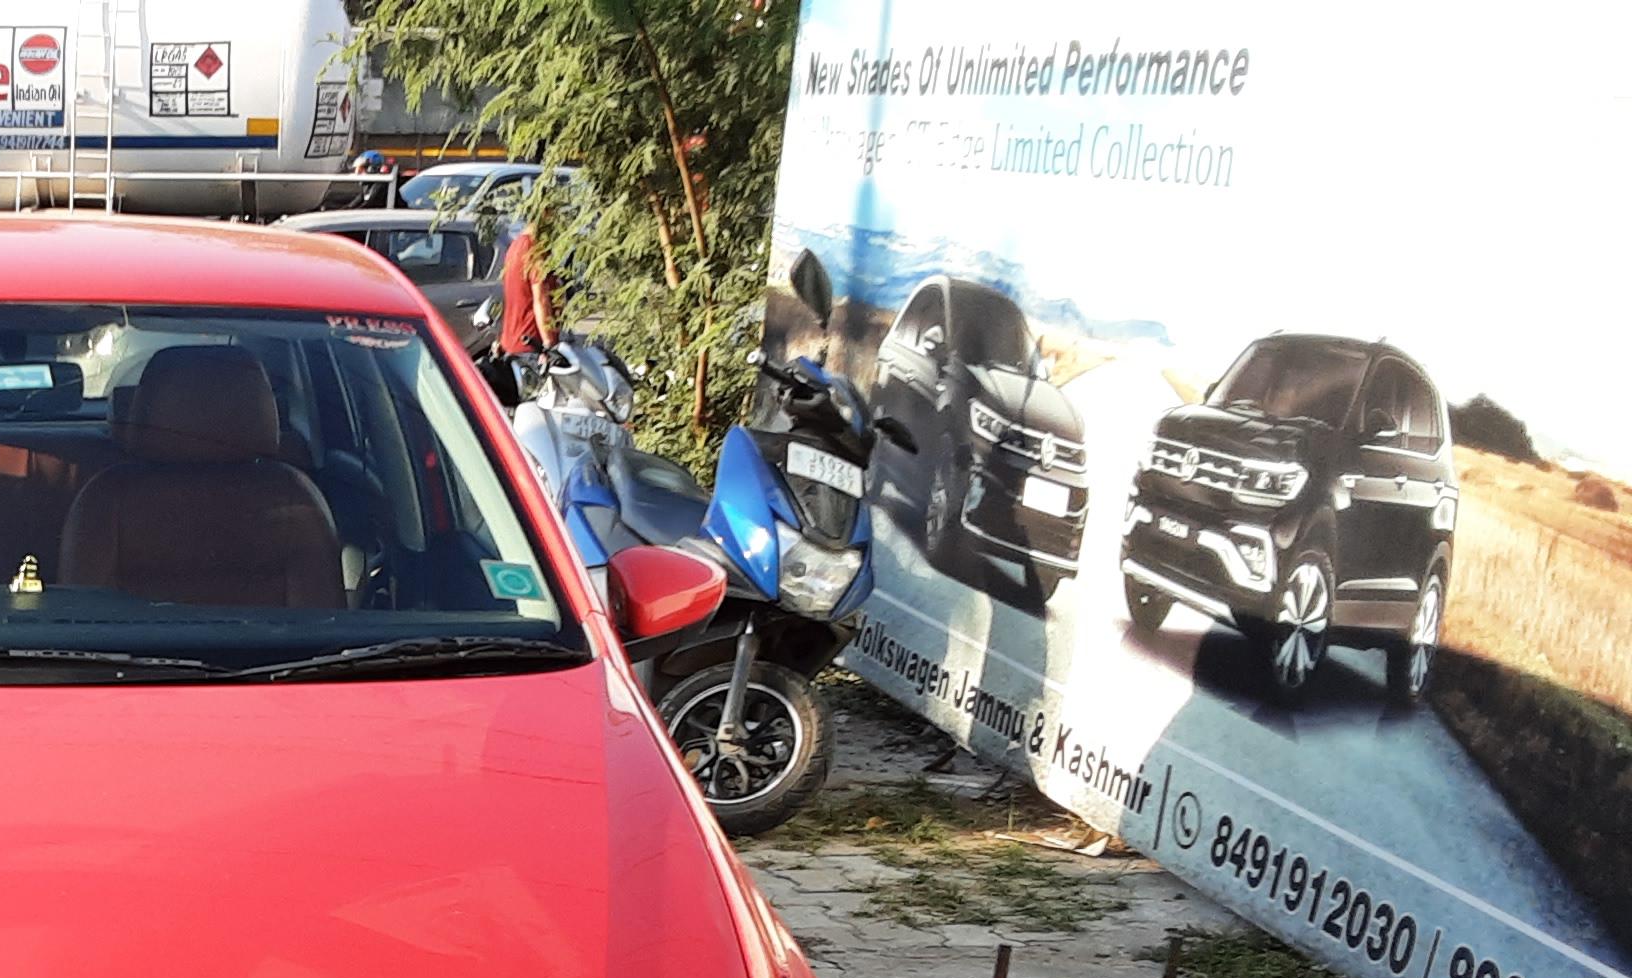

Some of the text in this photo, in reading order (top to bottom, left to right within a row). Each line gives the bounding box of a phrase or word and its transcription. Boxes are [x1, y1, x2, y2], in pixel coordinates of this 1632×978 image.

[16, 83, 47, 102] Indian
[805, 36, 1250, 97] New Shades Of Unlimited Performance
[990, 121, 1085, 177] Limited
[1090, 121, 1235, 188] Collection
[954, 670, 1027, 743] Jammu
[1029, 711, 1046, 757] &
[1052, 723, 1153, 815] Kashmir
[1210, 815, 1417, 975] 8491912030
